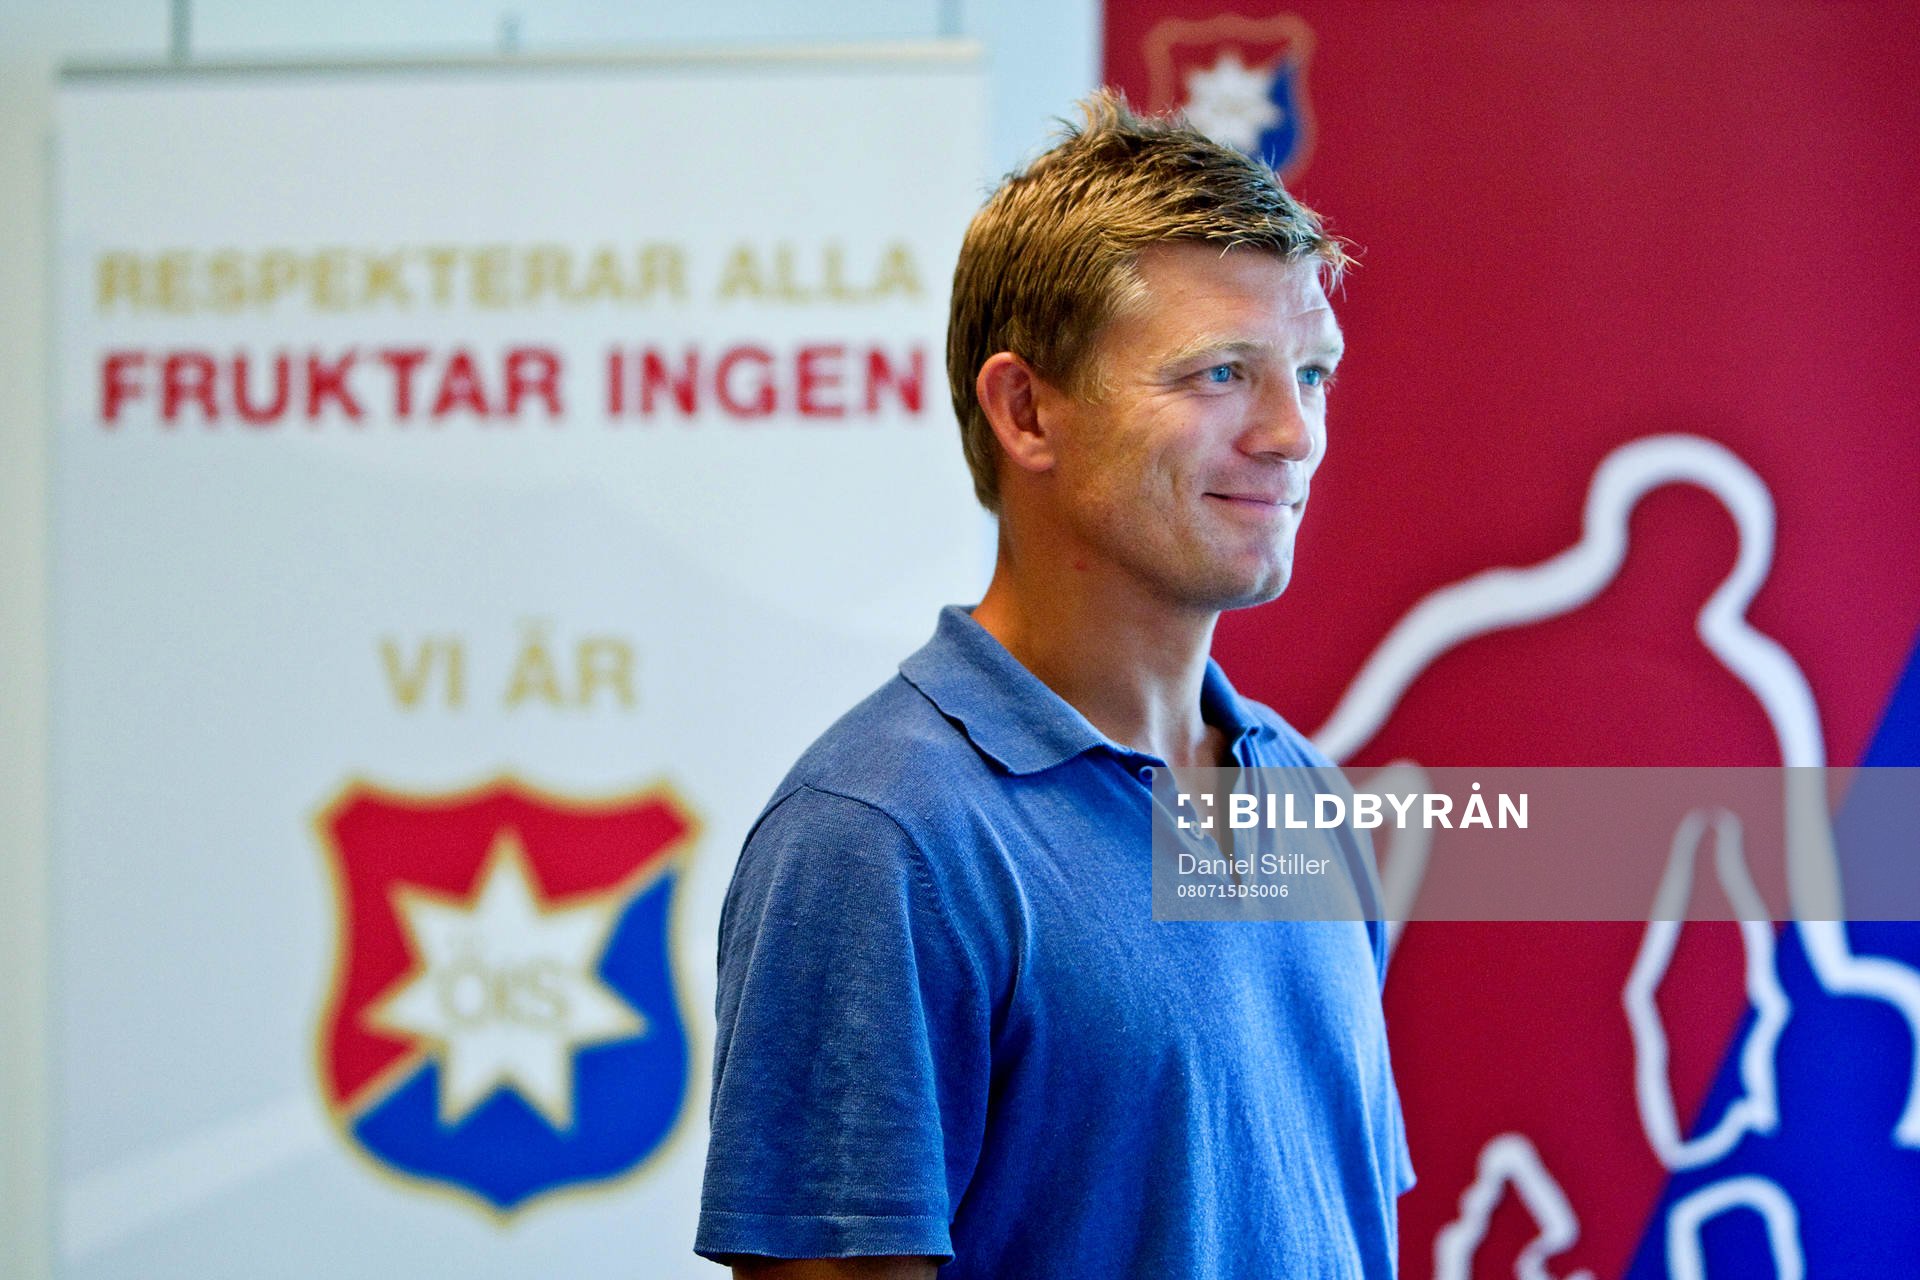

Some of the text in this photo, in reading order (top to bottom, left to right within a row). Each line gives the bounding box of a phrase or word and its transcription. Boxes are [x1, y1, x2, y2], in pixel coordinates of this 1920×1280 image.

[95, 242, 922, 312] RESPEKTERAR ALLA
[100, 345, 926, 426] FRUKTAR INGEN
[378, 616, 638, 711] VI ÄR
